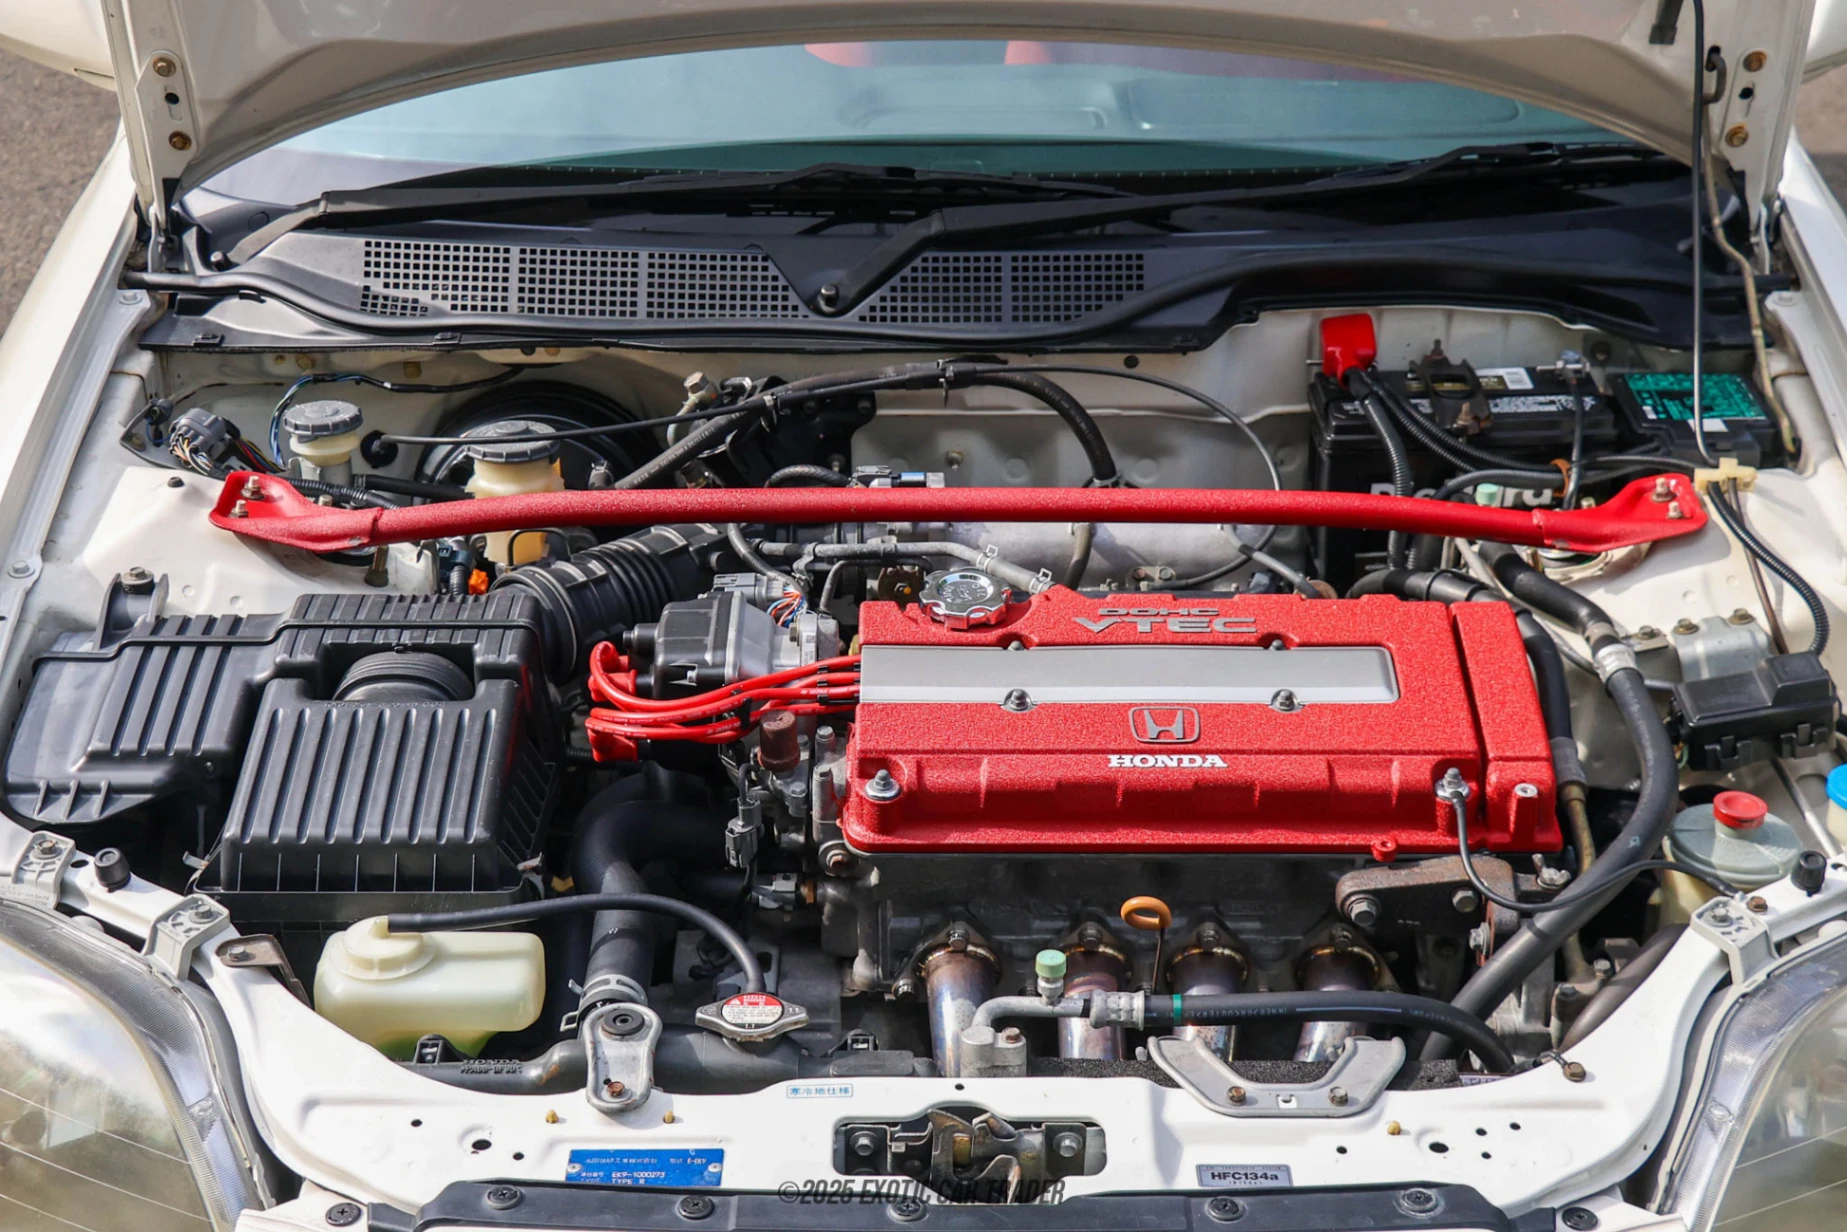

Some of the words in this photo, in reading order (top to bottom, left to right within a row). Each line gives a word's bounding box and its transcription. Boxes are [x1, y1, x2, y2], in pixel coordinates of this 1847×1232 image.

[1098, 607, 1220, 616] DOHC
[1072, 617, 1257, 634] VTEC
[1107, 754, 1229, 768] HONDA
[1210, 1171, 1280, 1181] HFC134a
